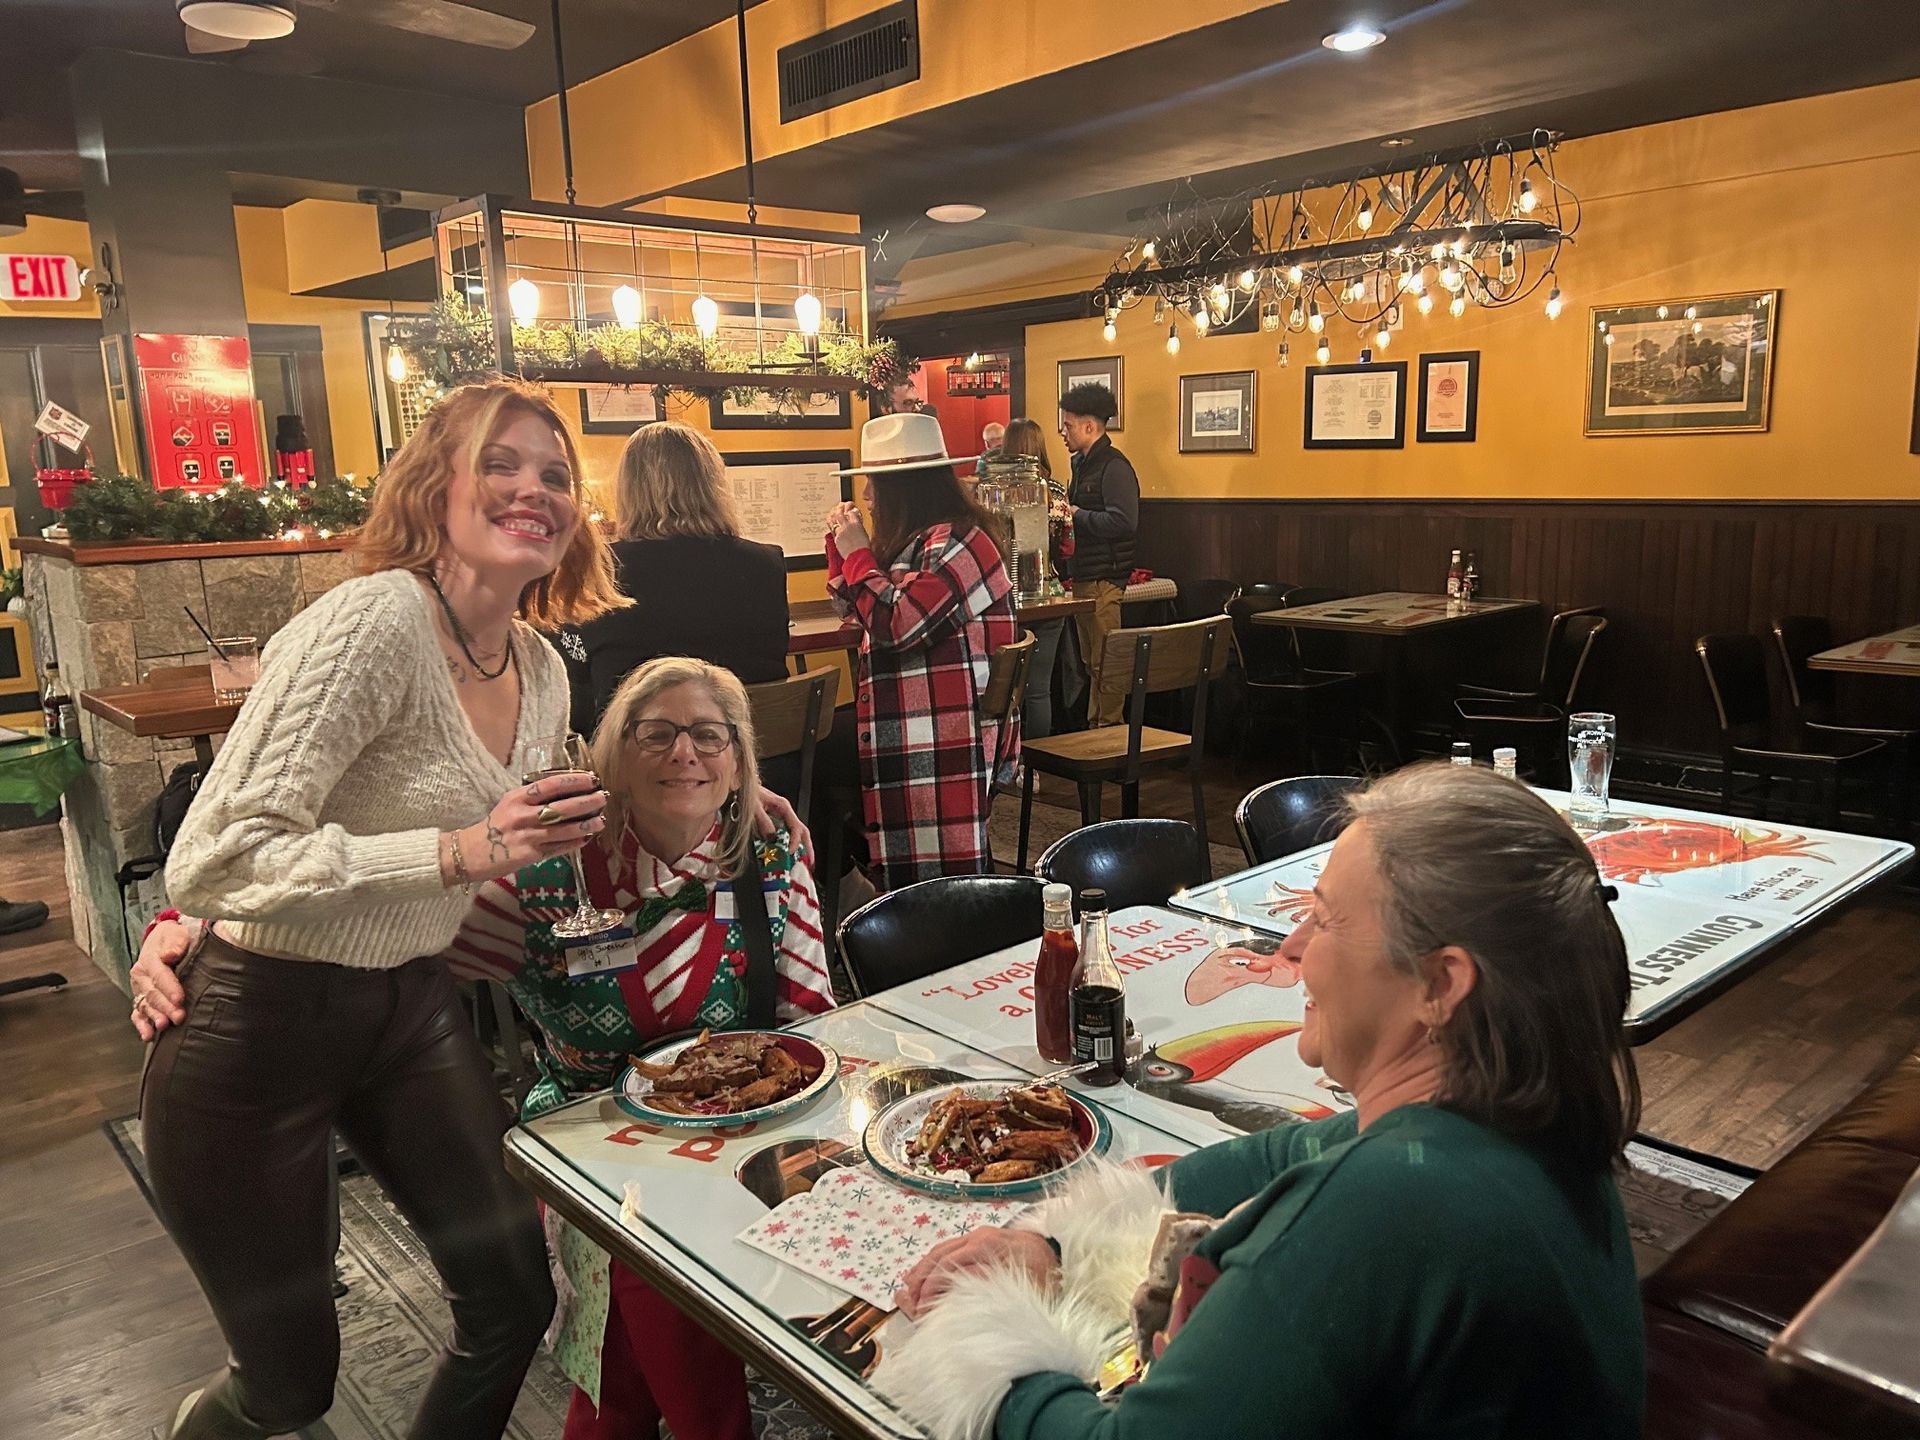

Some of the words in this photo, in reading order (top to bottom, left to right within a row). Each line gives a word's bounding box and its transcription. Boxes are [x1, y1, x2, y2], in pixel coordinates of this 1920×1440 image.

[8, 255, 68, 298] EXIT
[1724, 886, 1766, 902] Have
[1753, 877, 1785, 888] this
[1777, 866, 1803, 878] one
[1772, 887, 1805, 901] with
[1109, 919, 1163, 939] for
[1634, 914, 1764, 973] GUINNESS
[999, 1003, 1033, 1018] a
